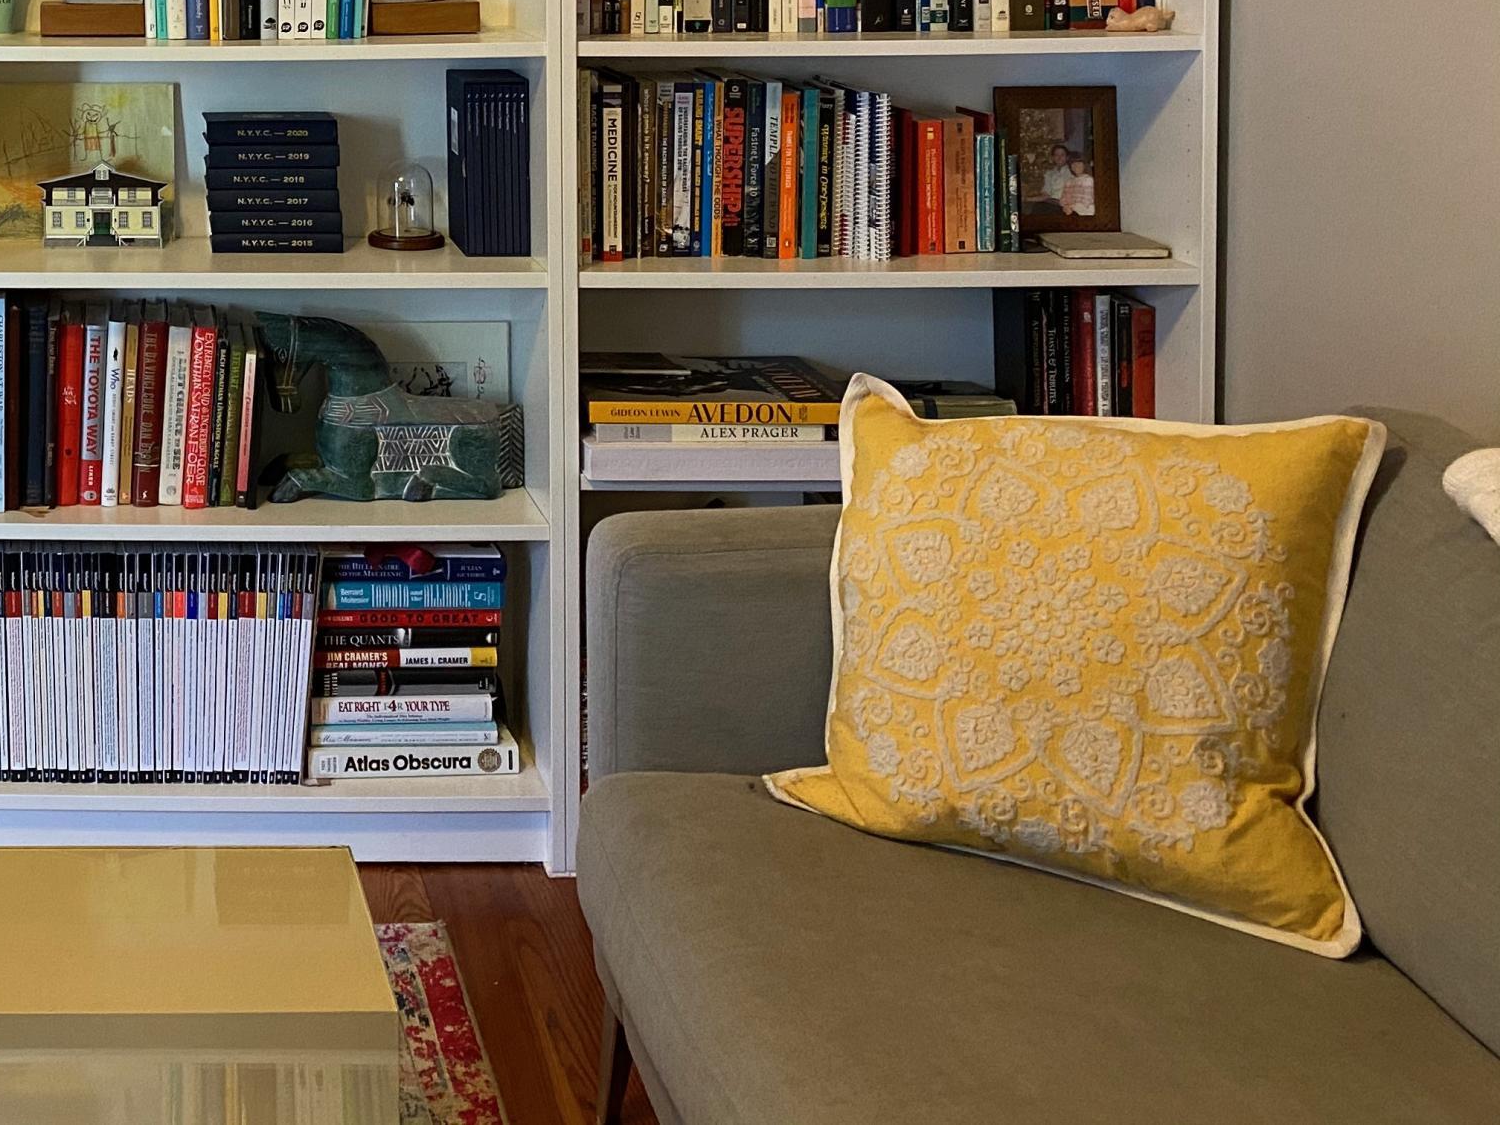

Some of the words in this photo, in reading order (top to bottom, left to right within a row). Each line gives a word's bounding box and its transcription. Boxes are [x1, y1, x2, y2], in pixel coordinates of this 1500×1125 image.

[714, 119, 722, 143] WHAT
[607, 118, 617, 182] MEDICINE
[749, 127, 759, 161] Fastnet,
[714, 143, 722, 178] THOUGH
[723, 107, 744, 212] SUPERSHIP
[749, 163, 759, 185] Force
[714, 179, 722, 196] THE
[749, 187, 759, 197] 10
[714, 197, 722, 220] ODDS
[86, 335, 101, 364] THE
[144, 332, 156, 349] THE
[144, 351, 156, 364] DA
[192, 331, 204, 390] JONATHAN
[202, 332, 214, 381] EXTREMELY
[219, 348, 227, 367] BACH
[110, 368, 120, 389] Who
[144, 365, 156, 390] VINCI
[177, 357, 187, 388] LAST
[231, 351, 241, 389] STEWART
[86, 367, 101, 420] TOYOTA
[126, 368, 134, 404] HEADS
[202, 382, 214, 407] LOUD
[217, 368, 225, 402] JONATHAN
[144, 392, 156, 414] CODE
[175, 390, 185, 437] CHANCE
[188, 391, 201, 439] SAFRAN
[609, 408, 647, 417] GIDEON
[649, 408, 681, 417] LEWIN
[686, 403, 793, 423] AVEDON
[142, 421, 153, 439] DAN
[215, 401, 224, 440] LIVINGSTON
[86, 424, 101, 456] WAY
[199, 414, 210, 458] INCREDIBLY
[699, 427, 737, 439] ALEX
[741, 427, 799, 439] PRAGER
[172, 449, 182, 471] SEE
[186, 441, 199, 484] FOER
[212, 440, 222, 469] SEAGULL
[196, 458, 208, 486] CLOSE
[340, 588, 364, 596] Bernard
[359, 613, 399, 623] GOOD
[406, 613, 424, 623] TO
[432, 613, 480, 623] GREAT
[323, 634, 347, 645] THE
[349, 634, 400, 645] QUANTS
[326, 652, 342, 661] JIM
[344, 652, 388, 661] CRAMER'S
[404, 656, 429, 665] JAMES
[437, 656, 469, 665] CRAMER
[338, 701, 354, 712] EAT
[354, 701, 380, 712] RIGHT
[404, 701, 428, 712] YOUR
[431, 701, 451, 712] TYPE
[344, 755, 390, 773] Atlas
[392, 755, 472, 773] Obscura
